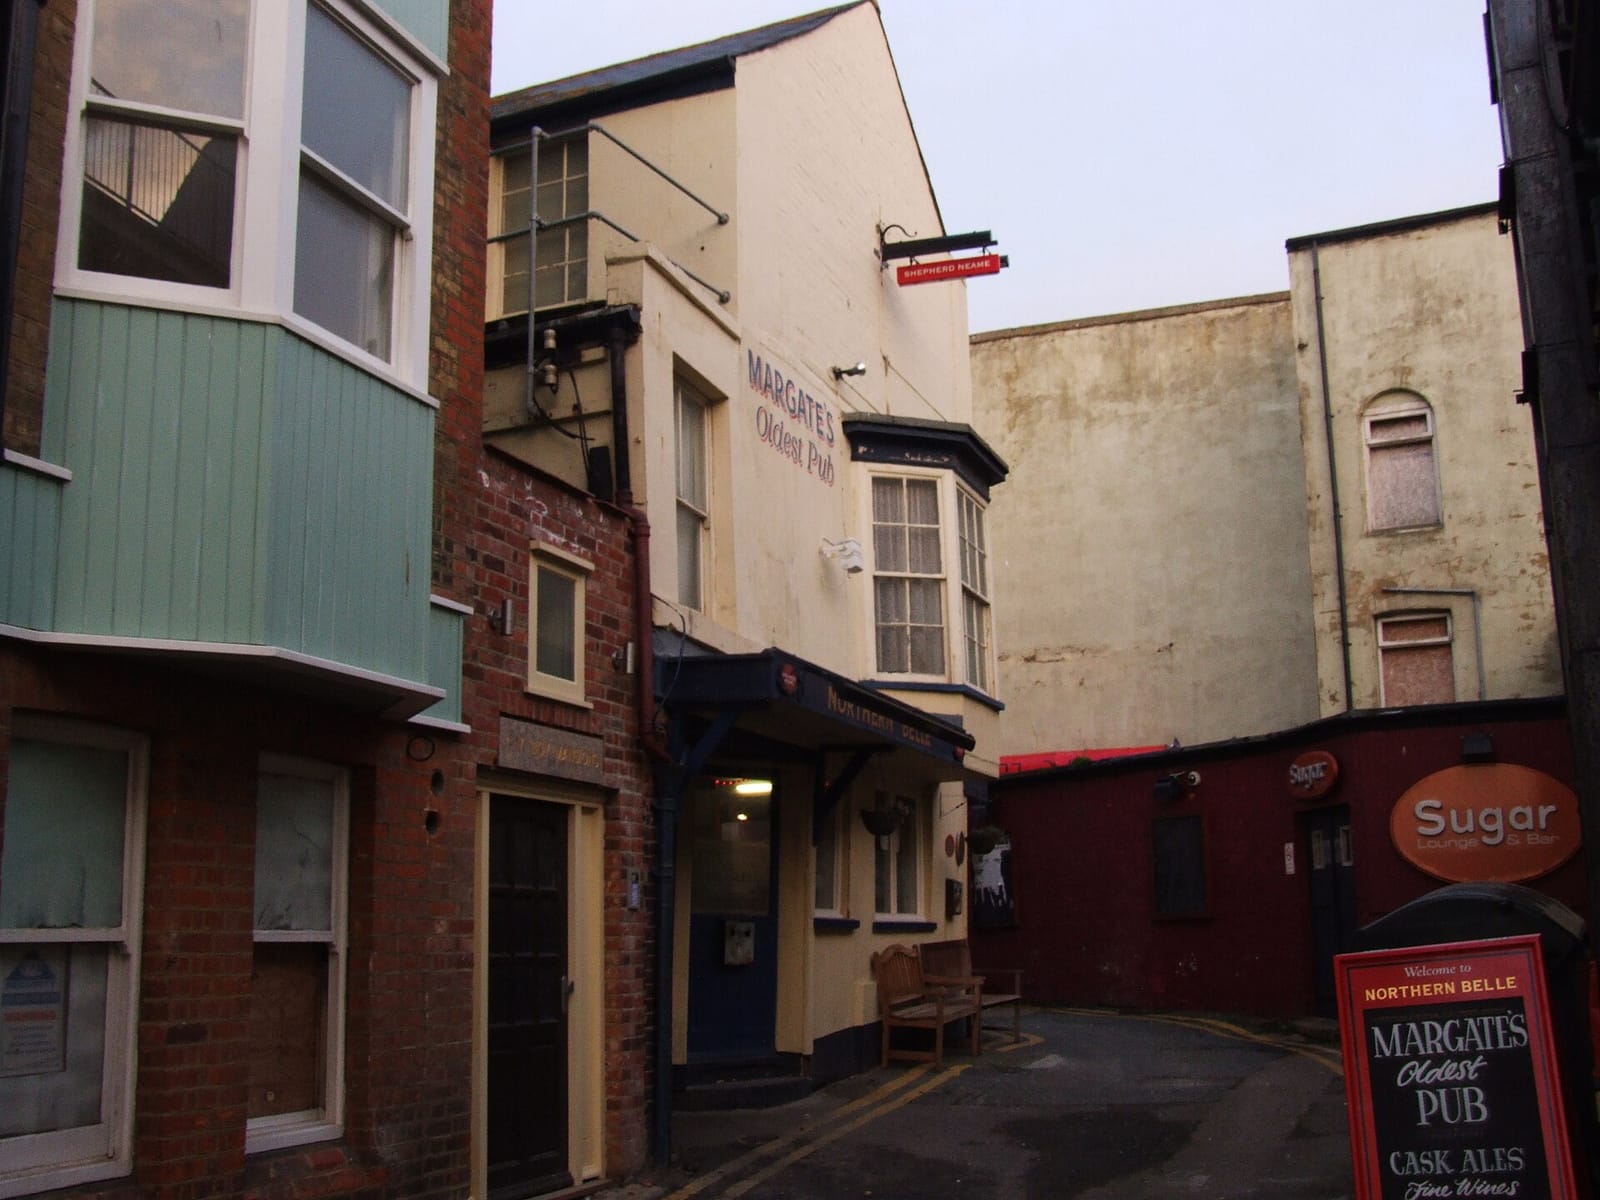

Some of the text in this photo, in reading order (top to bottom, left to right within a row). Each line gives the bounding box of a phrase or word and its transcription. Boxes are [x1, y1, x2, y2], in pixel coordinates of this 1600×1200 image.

[904, 259, 991, 278] SHEPHERD NEAME
[748, 348, 835, 448] MARGATE'S
[756, 406, 835, 487] Oldest Pub
[1289, 762, 1329, 789] Sugar
[1414, 799, 1557, 846] Sugar
[1416, 832, 1560, 851] Lounge & Bar
[1404, 963, 1472, 978] Welcome to
[1365, 976, 1518, 1001] NORTHERN BELLE
[1371, 1010, 1528, 1058] MARGATE'S
[1396, 1055, 1488, 1087] Oldest
[1416, 1086, 1488, 1126] PUB
[1389, 1147, 1524, 1176] CASK ALES
[1404, 1178, 1520, 1200] Fine Wines
